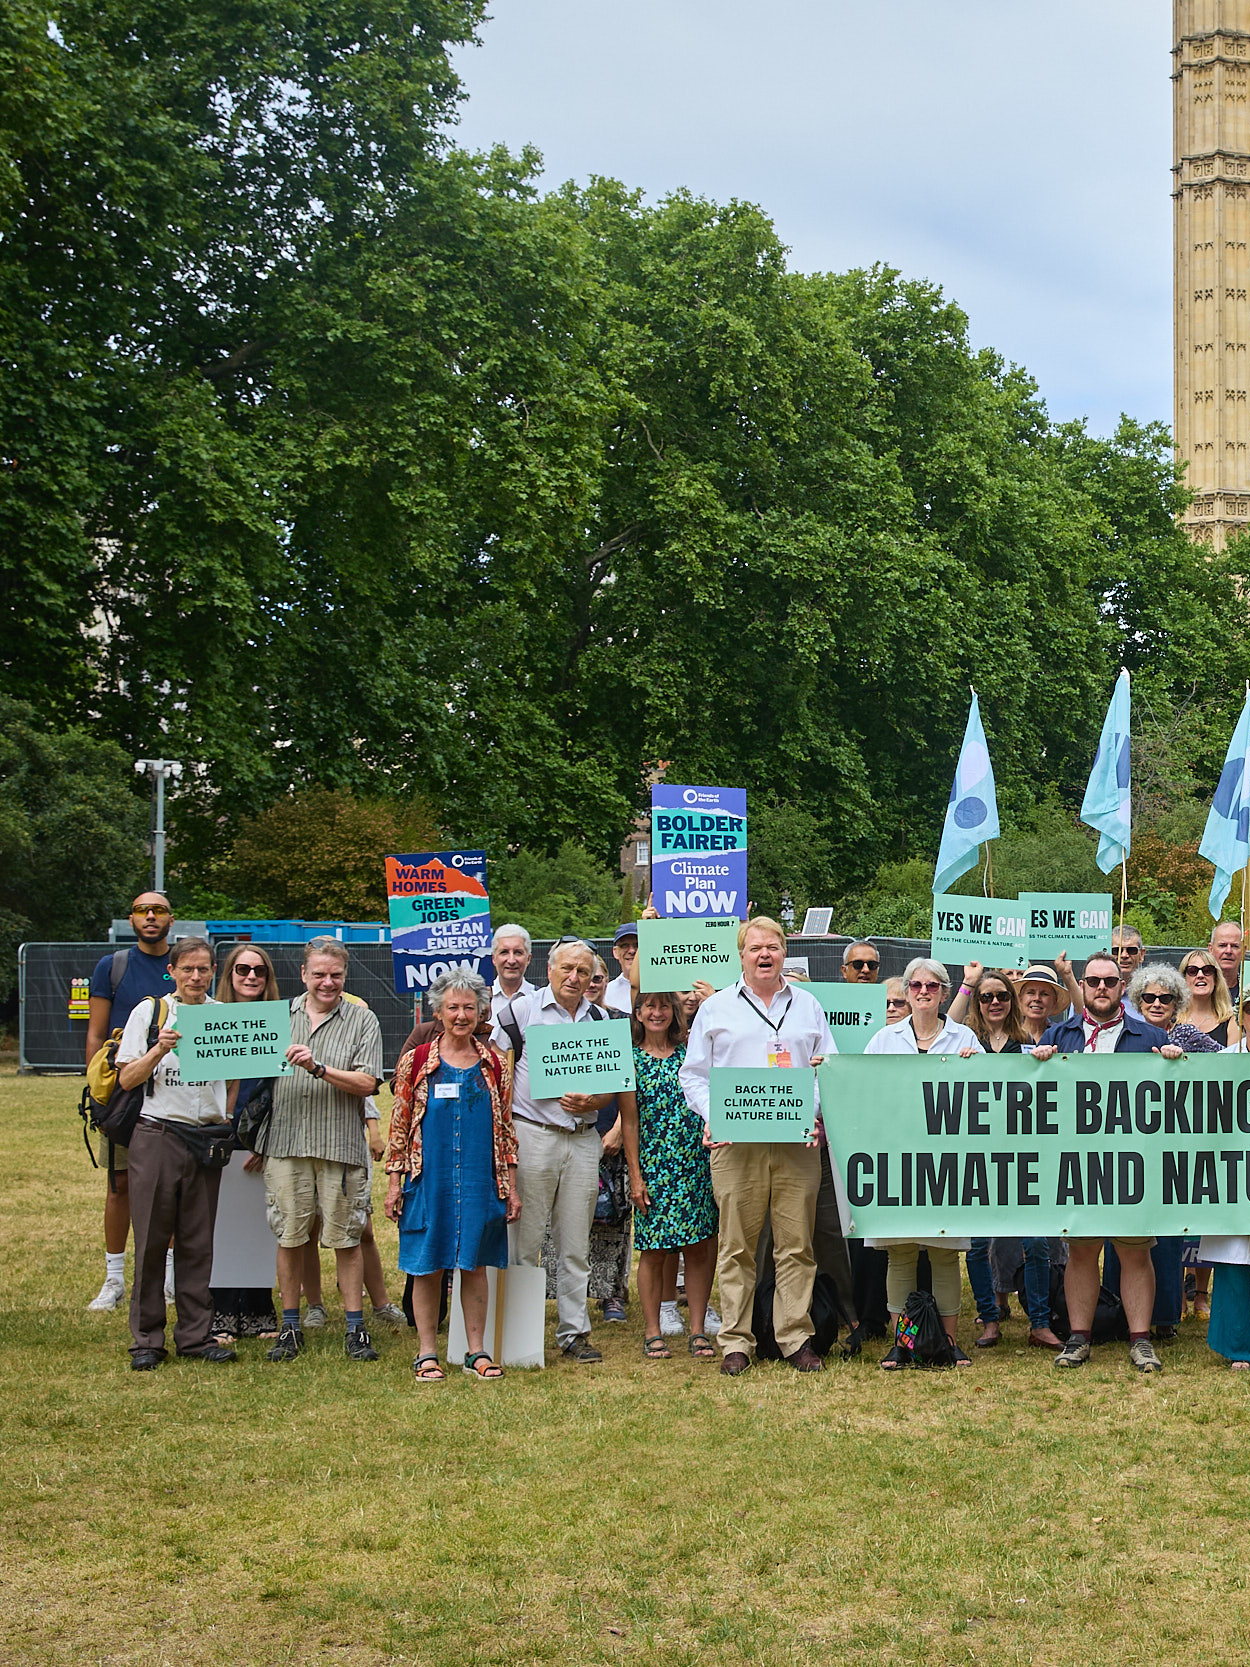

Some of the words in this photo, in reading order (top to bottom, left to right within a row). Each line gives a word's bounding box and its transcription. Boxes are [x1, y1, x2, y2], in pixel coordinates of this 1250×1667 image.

[657, 815, 743, 832] BOLDER
[661, 833, 737, 850] FAIRER
[395, 869, 444, 880] WARM
[670, 862, 729, 876] Climate
[392, 882, 447, 893] HOMES
[685, 877, 716, 890] Plan
[412, 897, 465, 912] GREEN
[665, 890, 737, 914] NOW
[420, 910, 460, 924] JOBS
[937, 911, 964, 932] YES
[969, 914, 992, 934] WE
[996, 916, 1026, 937] CAN
[1031, 910, 1048, 928] ES
[1053, 910, 1076, 928] WE
[1080, 910, 1109, 929] CAN
[431, 922, 483, 936] CLEAN
[427, 935, 489, 950] ENERGY
[663, 943, 717, 953] RESTORE
[651, 955, 698, 965] NATURE
[702, 954, 730, 963] NOW
[205, 1021, 238, 1031] BACK
[242, 1020, 267, 1029] THE
[830, 1011, 860, 1026] HOUR
[194, 1034, 249, 1045] CLIMATE
[252, 1032, 278, 1041] AND
[552, 1040, 582, 1050] BACK
[586, 1038, 609, 1047] THE
[197, 1047, 247, 1059] NATURE
[251, 1046, 278, 1056] BILL
[542, 1052, 593, 1064] CLIMATE
[597, 1050, 621, 1059] AND
[545, 1065, 592, 1076] NATURE
[596, 1063, 621, 1072] BILL
[735, 1085, 766, 1094] BACK
[770, 1085, 793, 1094] THE
[724, 1098, 776, 1107] CLIMATE
[779, 1098, 803, 1107] AND
[922, 1080, 1059, 1135] WE'RE
[726, 1111, 773, 1120] NATURE
[776, 1111, 802, 1121] BILL
[847, 1152, 1040, 1207] CLIMATE
[1056, 1151, 1144, 1206] AND
